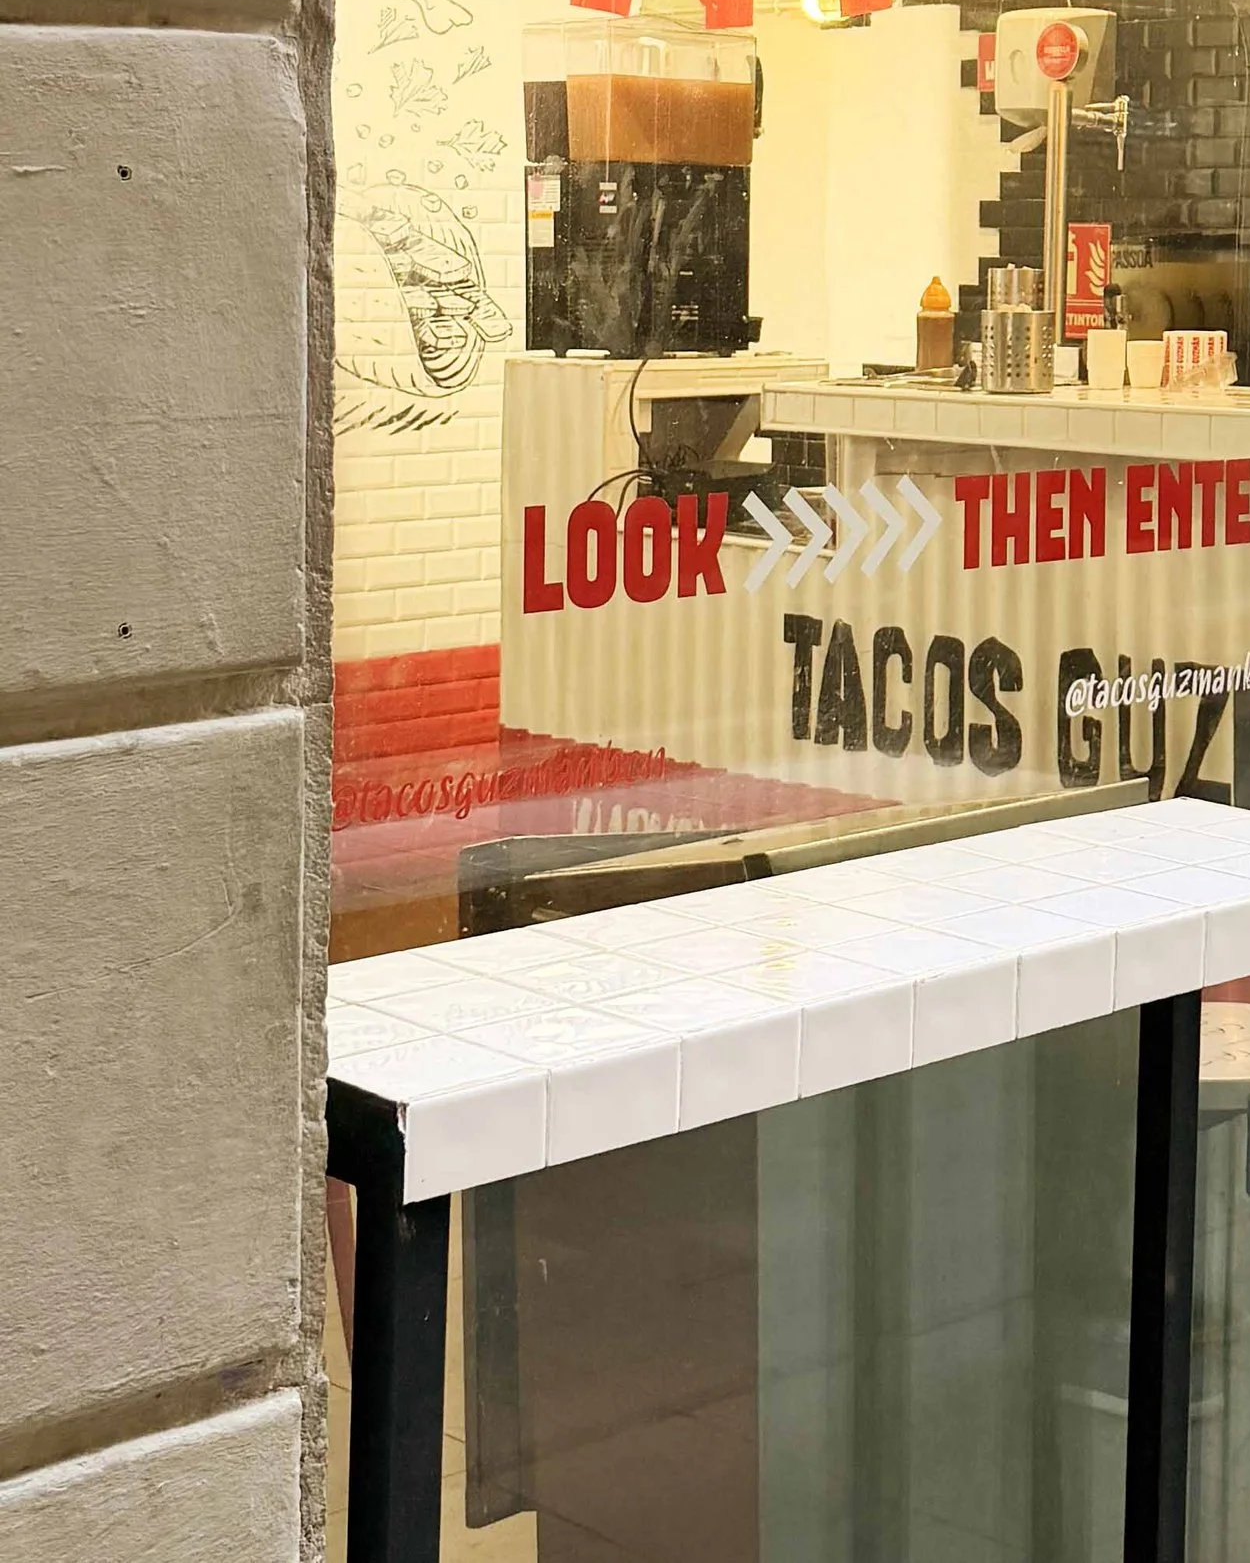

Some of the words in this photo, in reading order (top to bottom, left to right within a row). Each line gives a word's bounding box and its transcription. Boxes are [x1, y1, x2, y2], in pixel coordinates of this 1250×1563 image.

[523, 491, 729, 615] LOOK
[954, 468, 1107, 570] THEN
[783, 612, 1025, 778] TACOS
